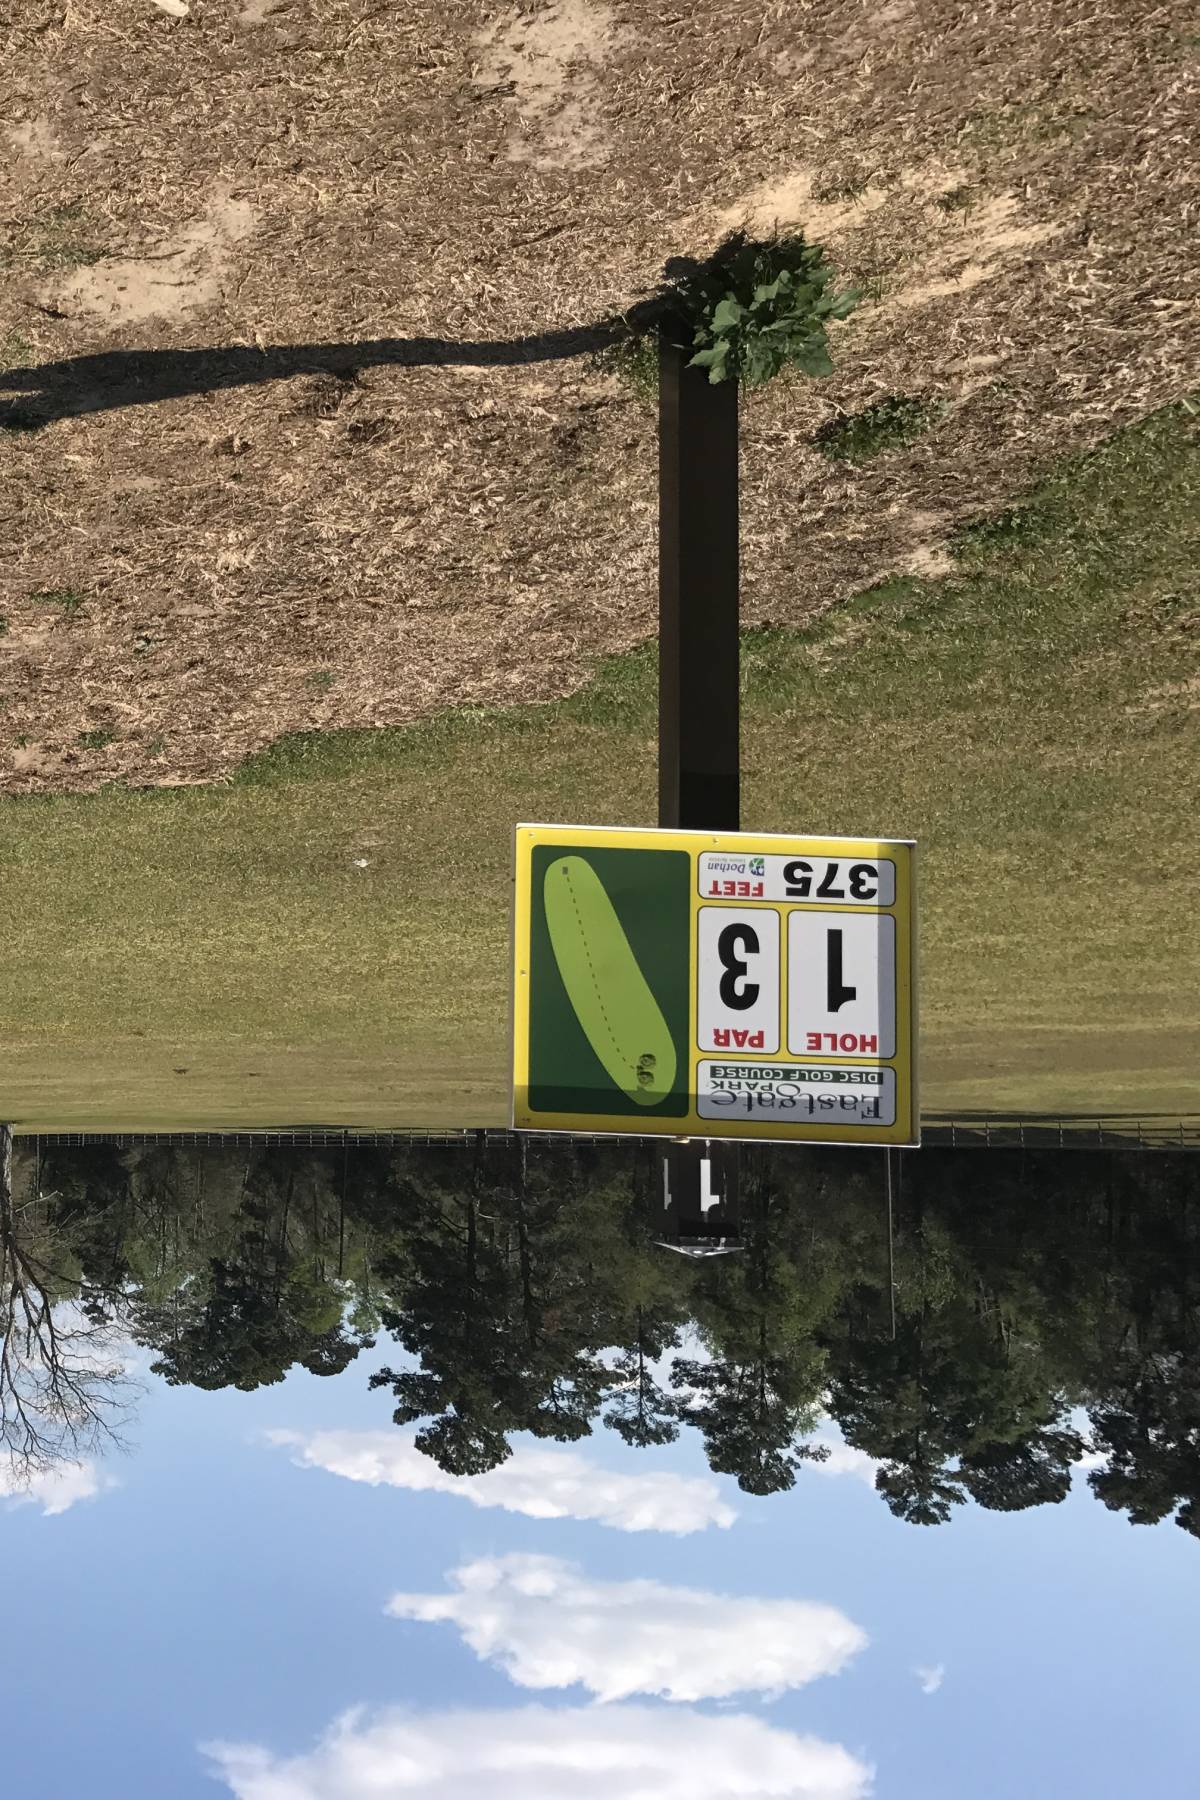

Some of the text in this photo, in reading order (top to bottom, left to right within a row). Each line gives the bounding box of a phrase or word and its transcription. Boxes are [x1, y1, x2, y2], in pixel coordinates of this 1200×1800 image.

[707, 862, 746, 874] Dothan
[708, 861, 879, 900] 375 FEET
[718, 923, 760, 1011] 3
[827, 929, 857, 1012] 1
[713, 1028, 764, 1048] PAR
[806, 1032, 877, 1053] HOLE
[711, 1080, 773, 1091] PARK
[715, 1067, 878, 1083] DISC GOLF COURSE
[710, 1084, 883, 1119] Eastgate
[701, 1159, 720, 1212] 1
